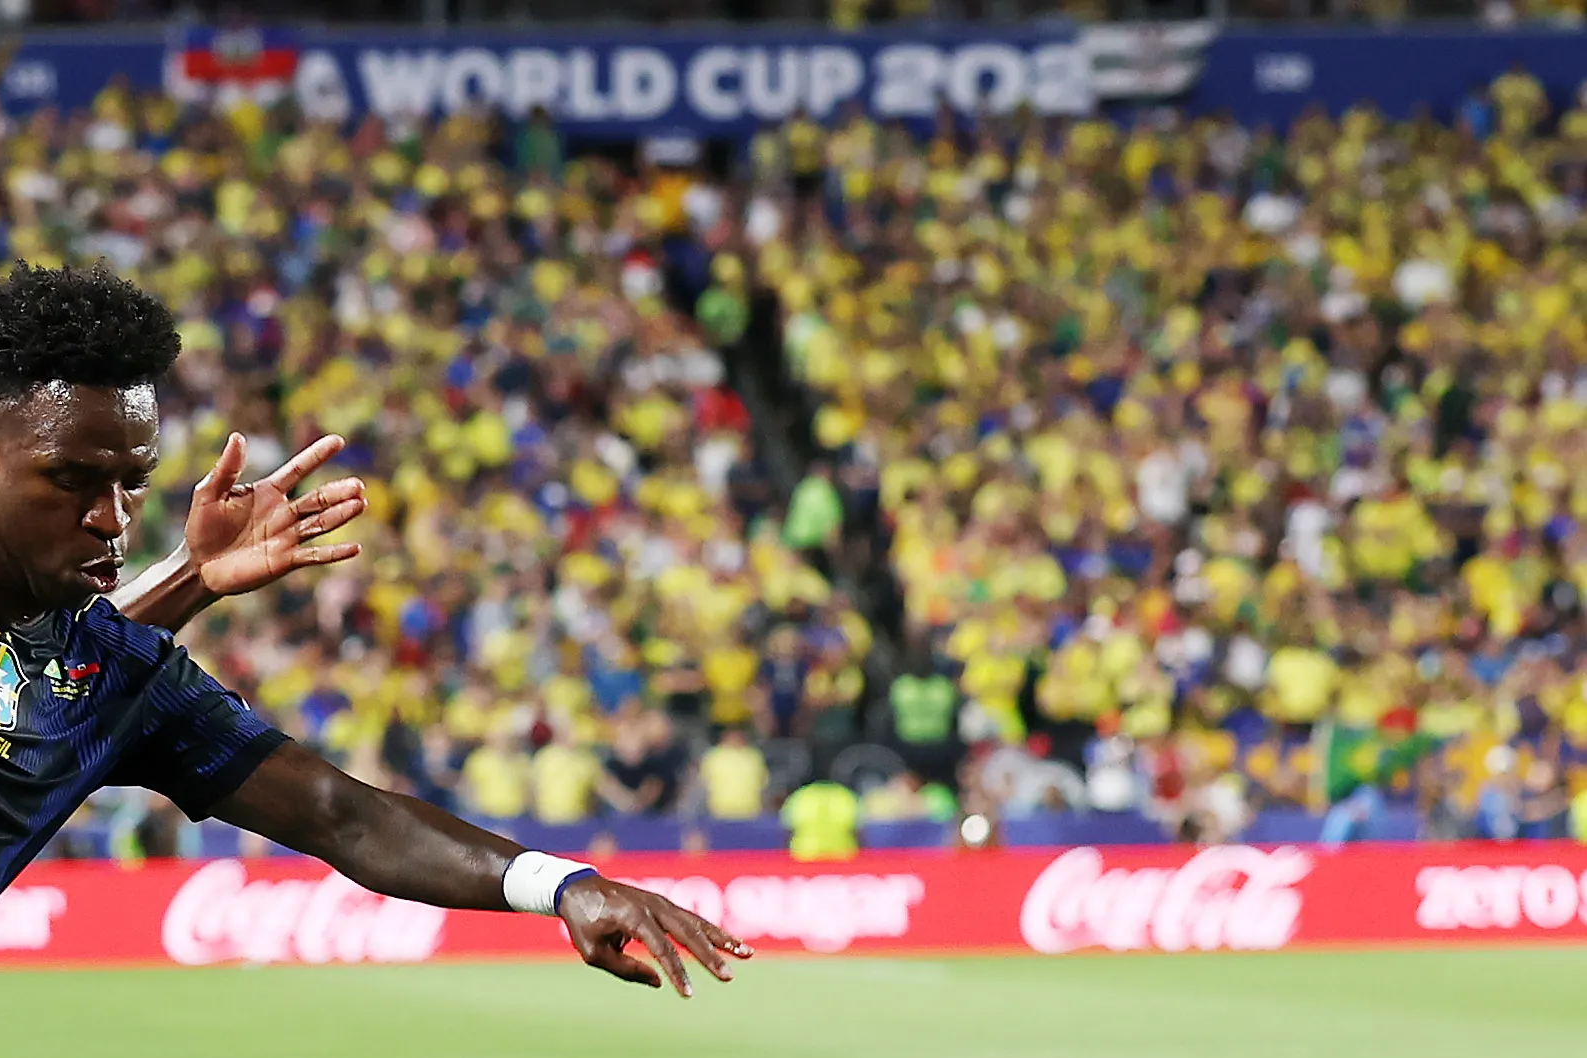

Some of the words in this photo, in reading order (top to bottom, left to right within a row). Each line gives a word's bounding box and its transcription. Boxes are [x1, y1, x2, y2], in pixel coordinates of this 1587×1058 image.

[356, 46, 679, 122] WORLD
[686, 45, 865, 120] CUP
[872, 43, 1097, 117] 202
[1019, 846, 1312, 953] Coca-Cola
